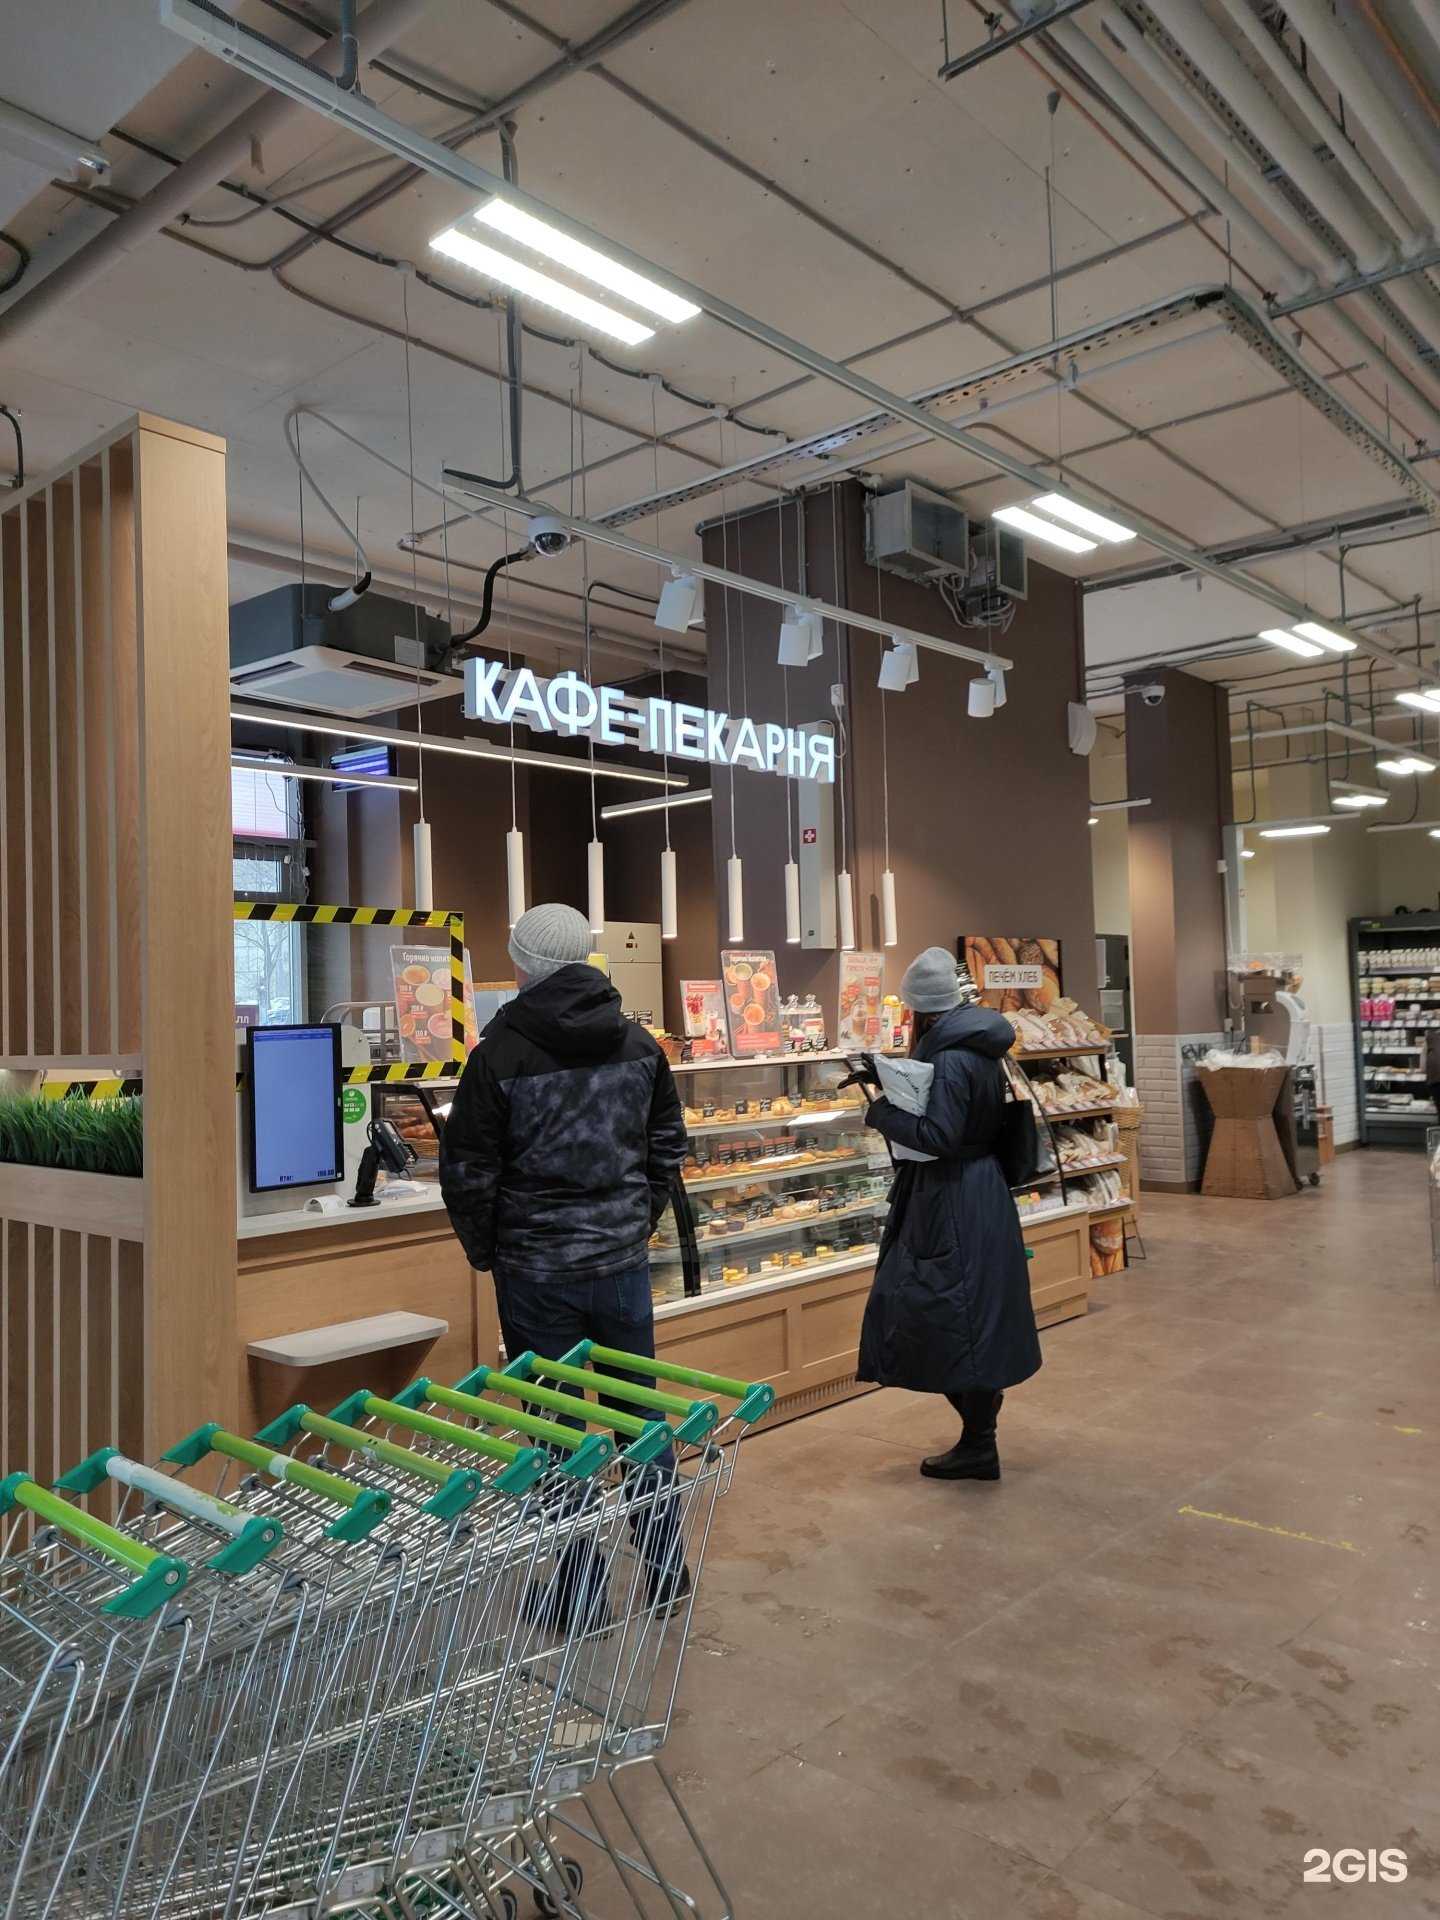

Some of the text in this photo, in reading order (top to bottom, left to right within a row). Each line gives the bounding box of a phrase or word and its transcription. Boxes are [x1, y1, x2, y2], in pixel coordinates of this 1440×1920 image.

[474, 656, 835, 783] КАФЕ-ПЕКАРНЯ
[989, 968, 1038, 983] ПЕЧЁМ ХЛЕБ
